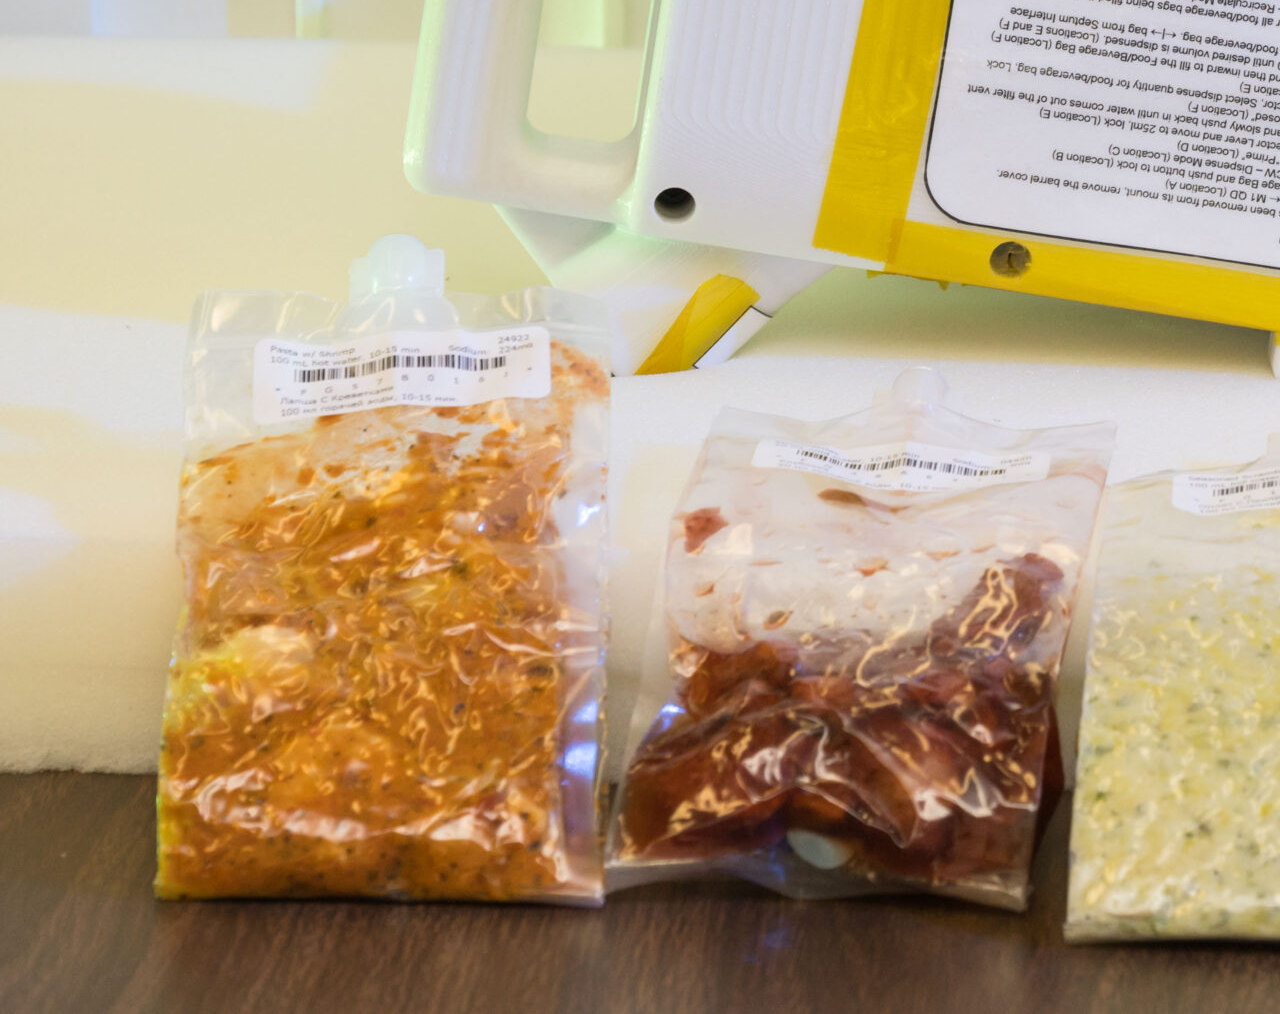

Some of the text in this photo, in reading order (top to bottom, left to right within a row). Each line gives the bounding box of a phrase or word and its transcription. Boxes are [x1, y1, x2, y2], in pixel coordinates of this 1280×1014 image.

[998, 16, 1010, 30] F)
[1011, 20, 1033, 32] and
[1034, 24, 1044, 36] E
[989, 29, 1002, 43] F)
[1044, 25, 1100, 44] (Locations
[1003, 33, 1053, 51] (Location
[1053, 39, 1076, 55] Bag
[1160, 42, 1170, 54] is
[1077, 43, 1158, 67] Food/Beverage
[1171, 44, 1210, 58] volume
[1210, 50, 1251, 66] desired
[985, 58, 1012, 73] Lock
[1159, 56, 1177, 69] the
[1178, 59, 1191, 72] fill
[1192, 61, 1204, 73] to
[1251, 56, 1275, 68] until
[1038, 65, 1114, 88] food/beverage
[1205, 63, 1241, 79] inward
[1242, 69, 1267, 82] then
[966, 83, 991, 95] vent
[1114, 78, 1131, 90] for
[1131, 78, 1174, 94] quantity
[1238, 80, 1252, 94] E)
[991, 87, 1016, 101] filter
[1016, 91, 1035, 103] the
[1035, 94, 1048, 105] of
[1048, 95, 1068, 106] out
[1174, 86, 1223, 103] dispense
[1223, 93, 1258, 109] Select
[1068, 98, 1105, 111] comes
[1105, 104, 1136, 116] water
[1038, 105, 1051, 120] E)
[1052, 109, 1102, 126] (Location
[1136, 108, 1160, 119] until
[1161, 111, 1172, 123] in
[1102, 117, 1126, 130] lock
[1172, 113, 1199, 127] back
[1200, 117, 1228, 129] push
[1228, 119, 1262, 135] slowly
[1157, 124, 1169, 136] to
[1169, 126, 1201, 138] move
[1201, 131, 1223, 142] and
[1223, 134, 1255, 148] Lever
[1051, 148, 1064, 162] B)
[1065, 152, 1114, 169] (Location
[1115, 159, 1138, 172] lock
[1139, 162, 1151, 173] to
[1151, 164, 1186, 178] button
[1028, 173, 1061, 188] barrel
[1187, 169, 1214, 181] push
[1214, 173, 1236, 184] and
[1237, 174, 1259, 189] Bag
[1061, 178, 1080, 191] the
[1080, 181, 1121, 195] remove
[1164, 177, 1178, 191] A)
[1178, 181, 1227, 198] (Location
[1160, 192, 1174, 203] its
[1175, 194, 1200, 208] from
[1228, 188, 1248, 201] QD
[1249, 192, 1267, 204] M1
[1200, 198, 1248, 212] removed
[1248, 205, 1277, 219] been
